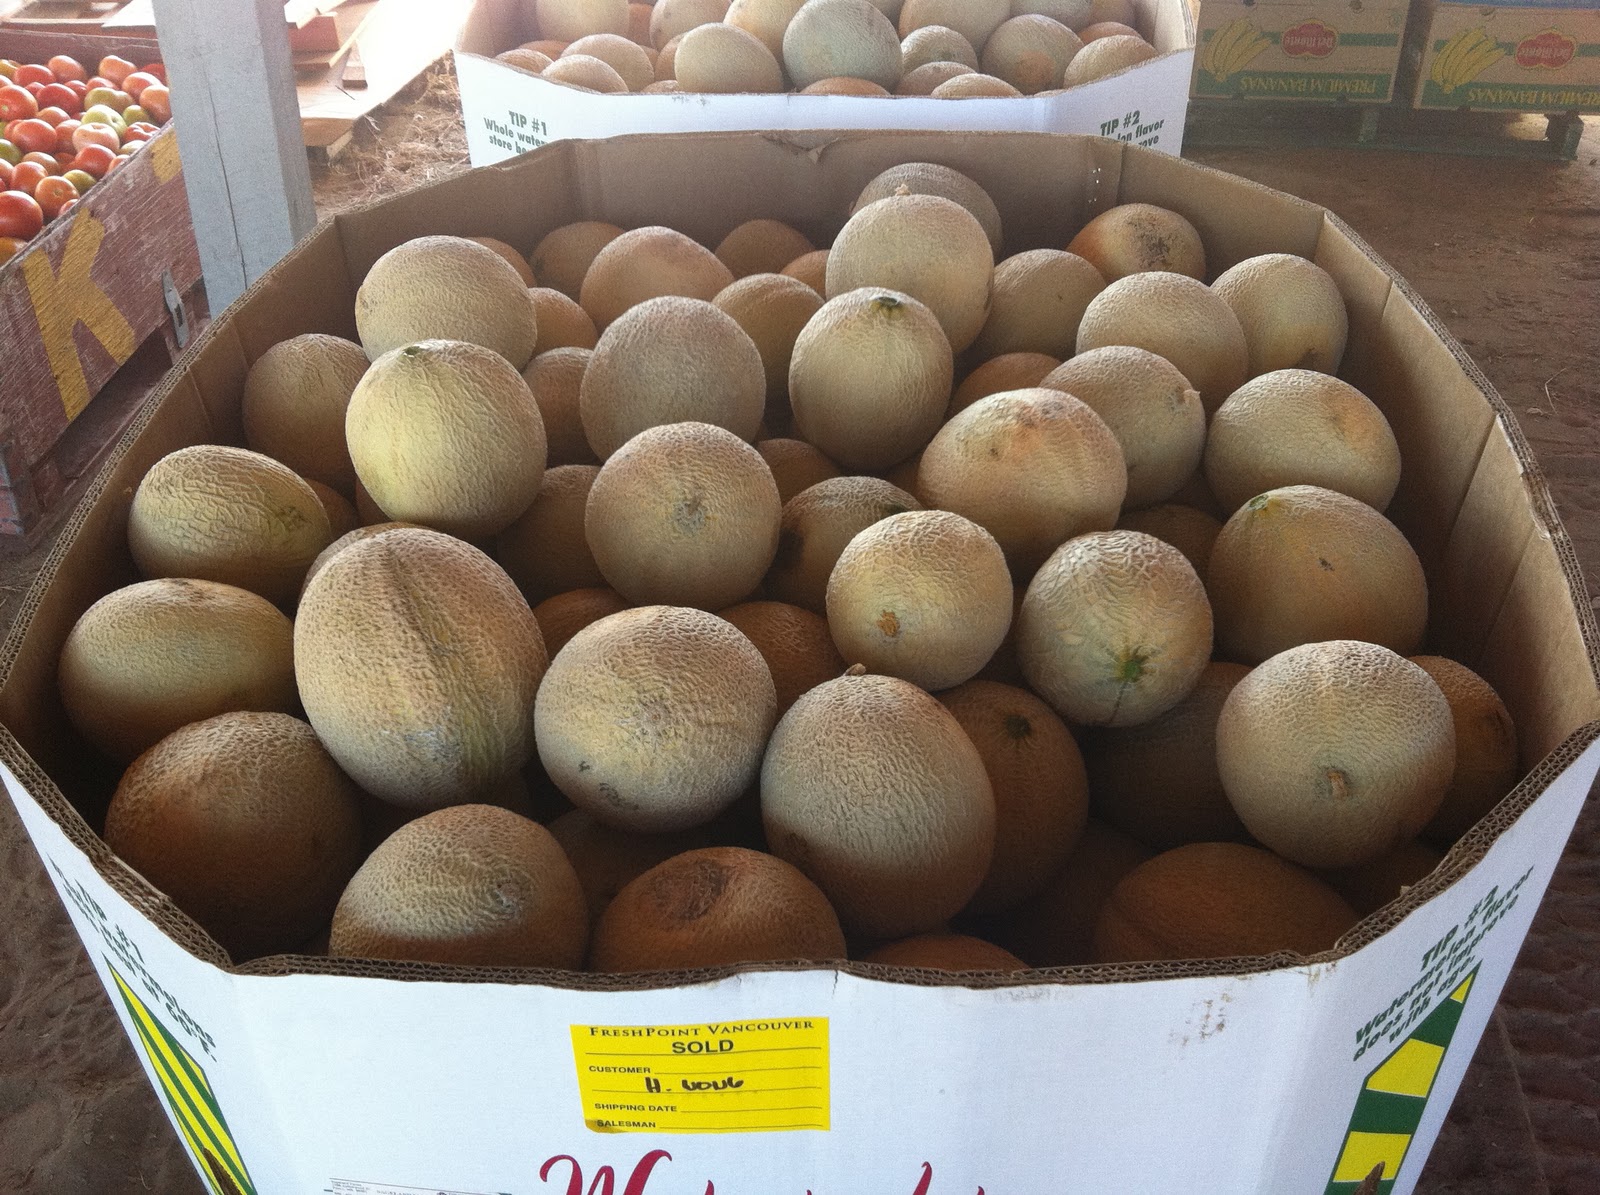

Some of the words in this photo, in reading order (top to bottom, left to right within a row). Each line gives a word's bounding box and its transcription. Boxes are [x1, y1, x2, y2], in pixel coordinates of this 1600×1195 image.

[1240, 77, 1307, 92] BANANAS
[1311, 78, 1376, 94] PREMIUM
[483, 117, 514, 138] Whole
[508, 110, 527, 128] TIP
[532, 117, 547, 136] #1
[1100, 118, 1119, 136] TIP
[1123, 110, 1140, 129] #2
[1136, 119, 1165, 138] flavor
[489, 134, 512, 151] store
[22, 207, 136, 422] K
[74, 878, 107, 921] TIP
[115, 923, 146, 966] #1
[1420, 924, 1459, 972] TIP
[1464, 885, 1499, 929] #2
[1356, 925, 1477, 1045] Watermelon
[1482, 864, 1534, 926] flavor
[97, 919, 217, 1049] watermelons
[1353, 1010, 1403, 1062] does
[1409, 970, 1443, 1013] not
[1447, 894, 1519, 975] improve
[707, 1020, 814, 1036] VANCOUVER
[1389, 997, 1431, 1044] with
[671, 1039, 735, 1055] SOLD
[588, 1065, 651, 1074] CUSTOMER
[594, 1103, 645, 1112] SHIPPING
[648, 1105, 678, 1113] DATE
[596, 1119, 656, 1128] SALESMAN
